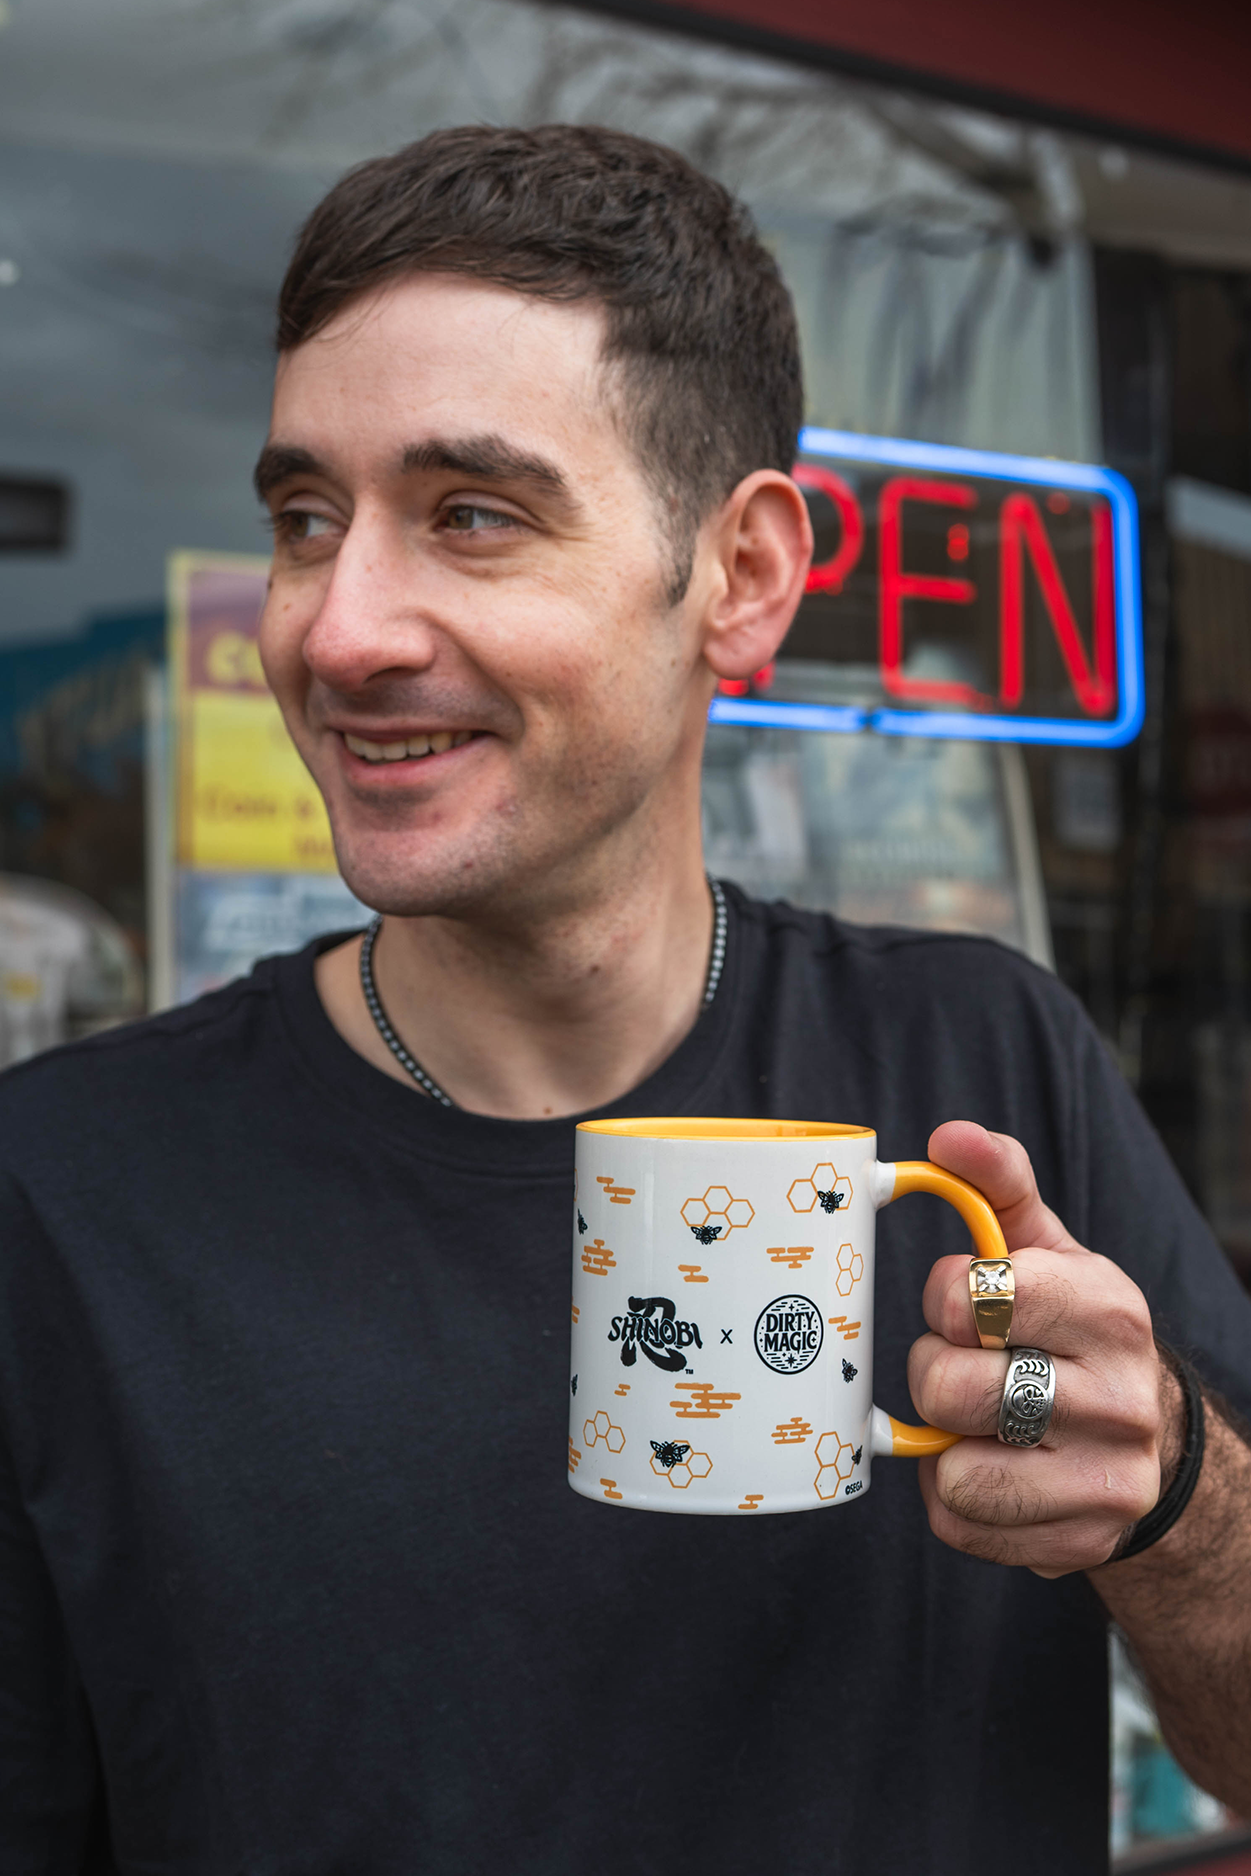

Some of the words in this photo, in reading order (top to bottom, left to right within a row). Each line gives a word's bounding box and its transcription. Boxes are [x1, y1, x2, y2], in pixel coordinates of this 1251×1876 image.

[607, 1316, 703, 1349] SHINOBI
[766, 1311, 815, 1332] DIRTY
[764, 1330, 817, 1354] MAGIC
